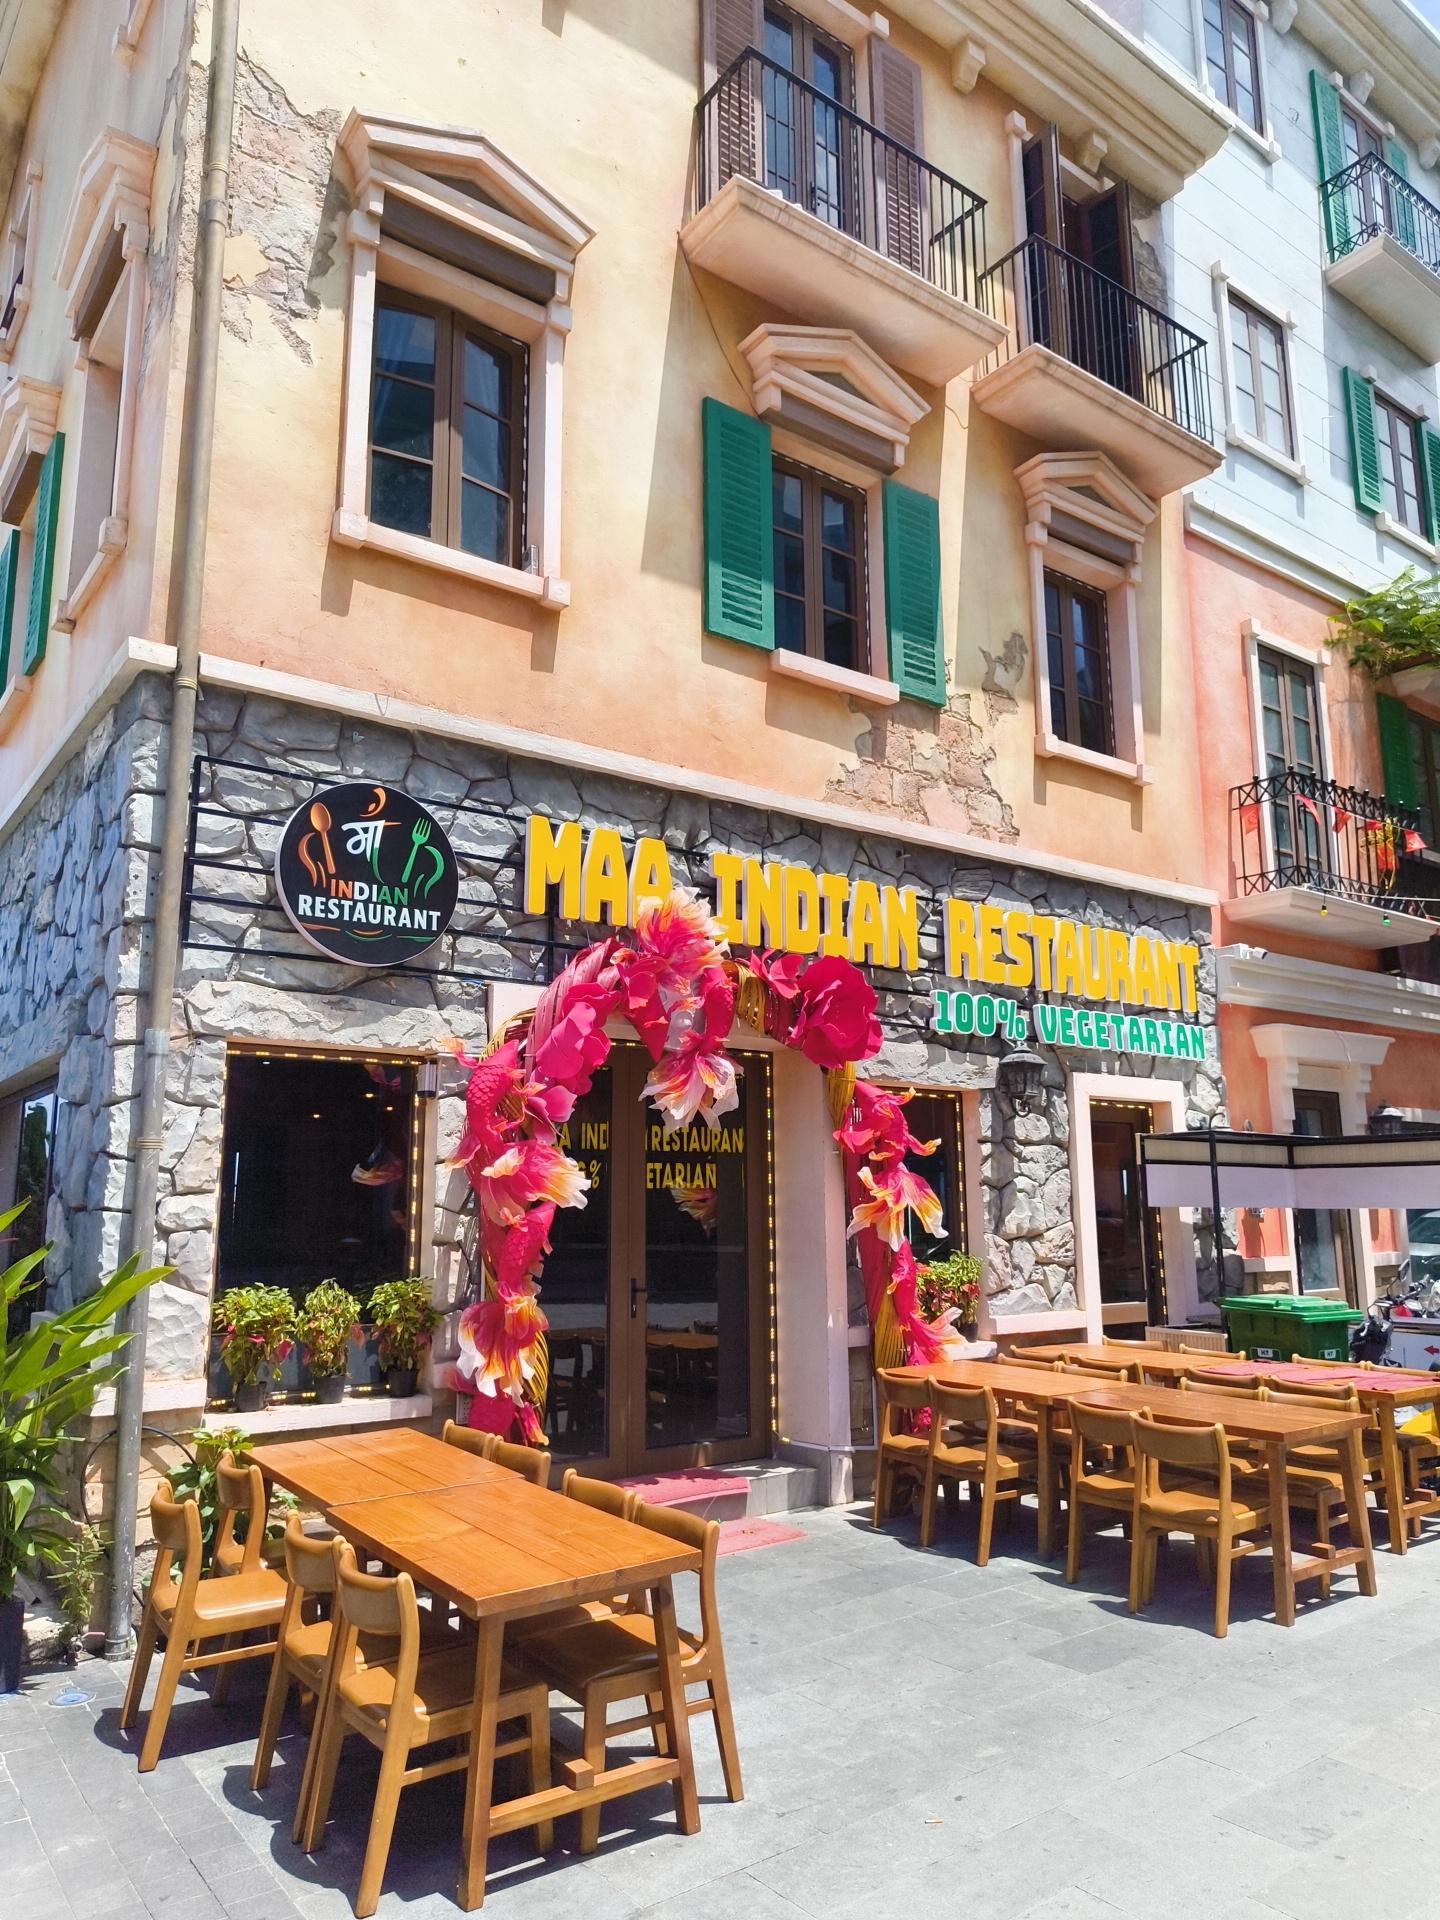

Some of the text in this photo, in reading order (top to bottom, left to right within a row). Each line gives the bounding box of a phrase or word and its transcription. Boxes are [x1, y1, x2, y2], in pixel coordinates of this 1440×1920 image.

[330, 879, 409, 905] INDIAN
[298, 894, 441, 931] RESTAURANT
[524, 815, 1199, 1012] MAA INDIAN RESTAURANT
[931, 990, 1206, 1061] 100% VEGETARIAN
[652, 1125, 744, 1153] RESTAURAN
